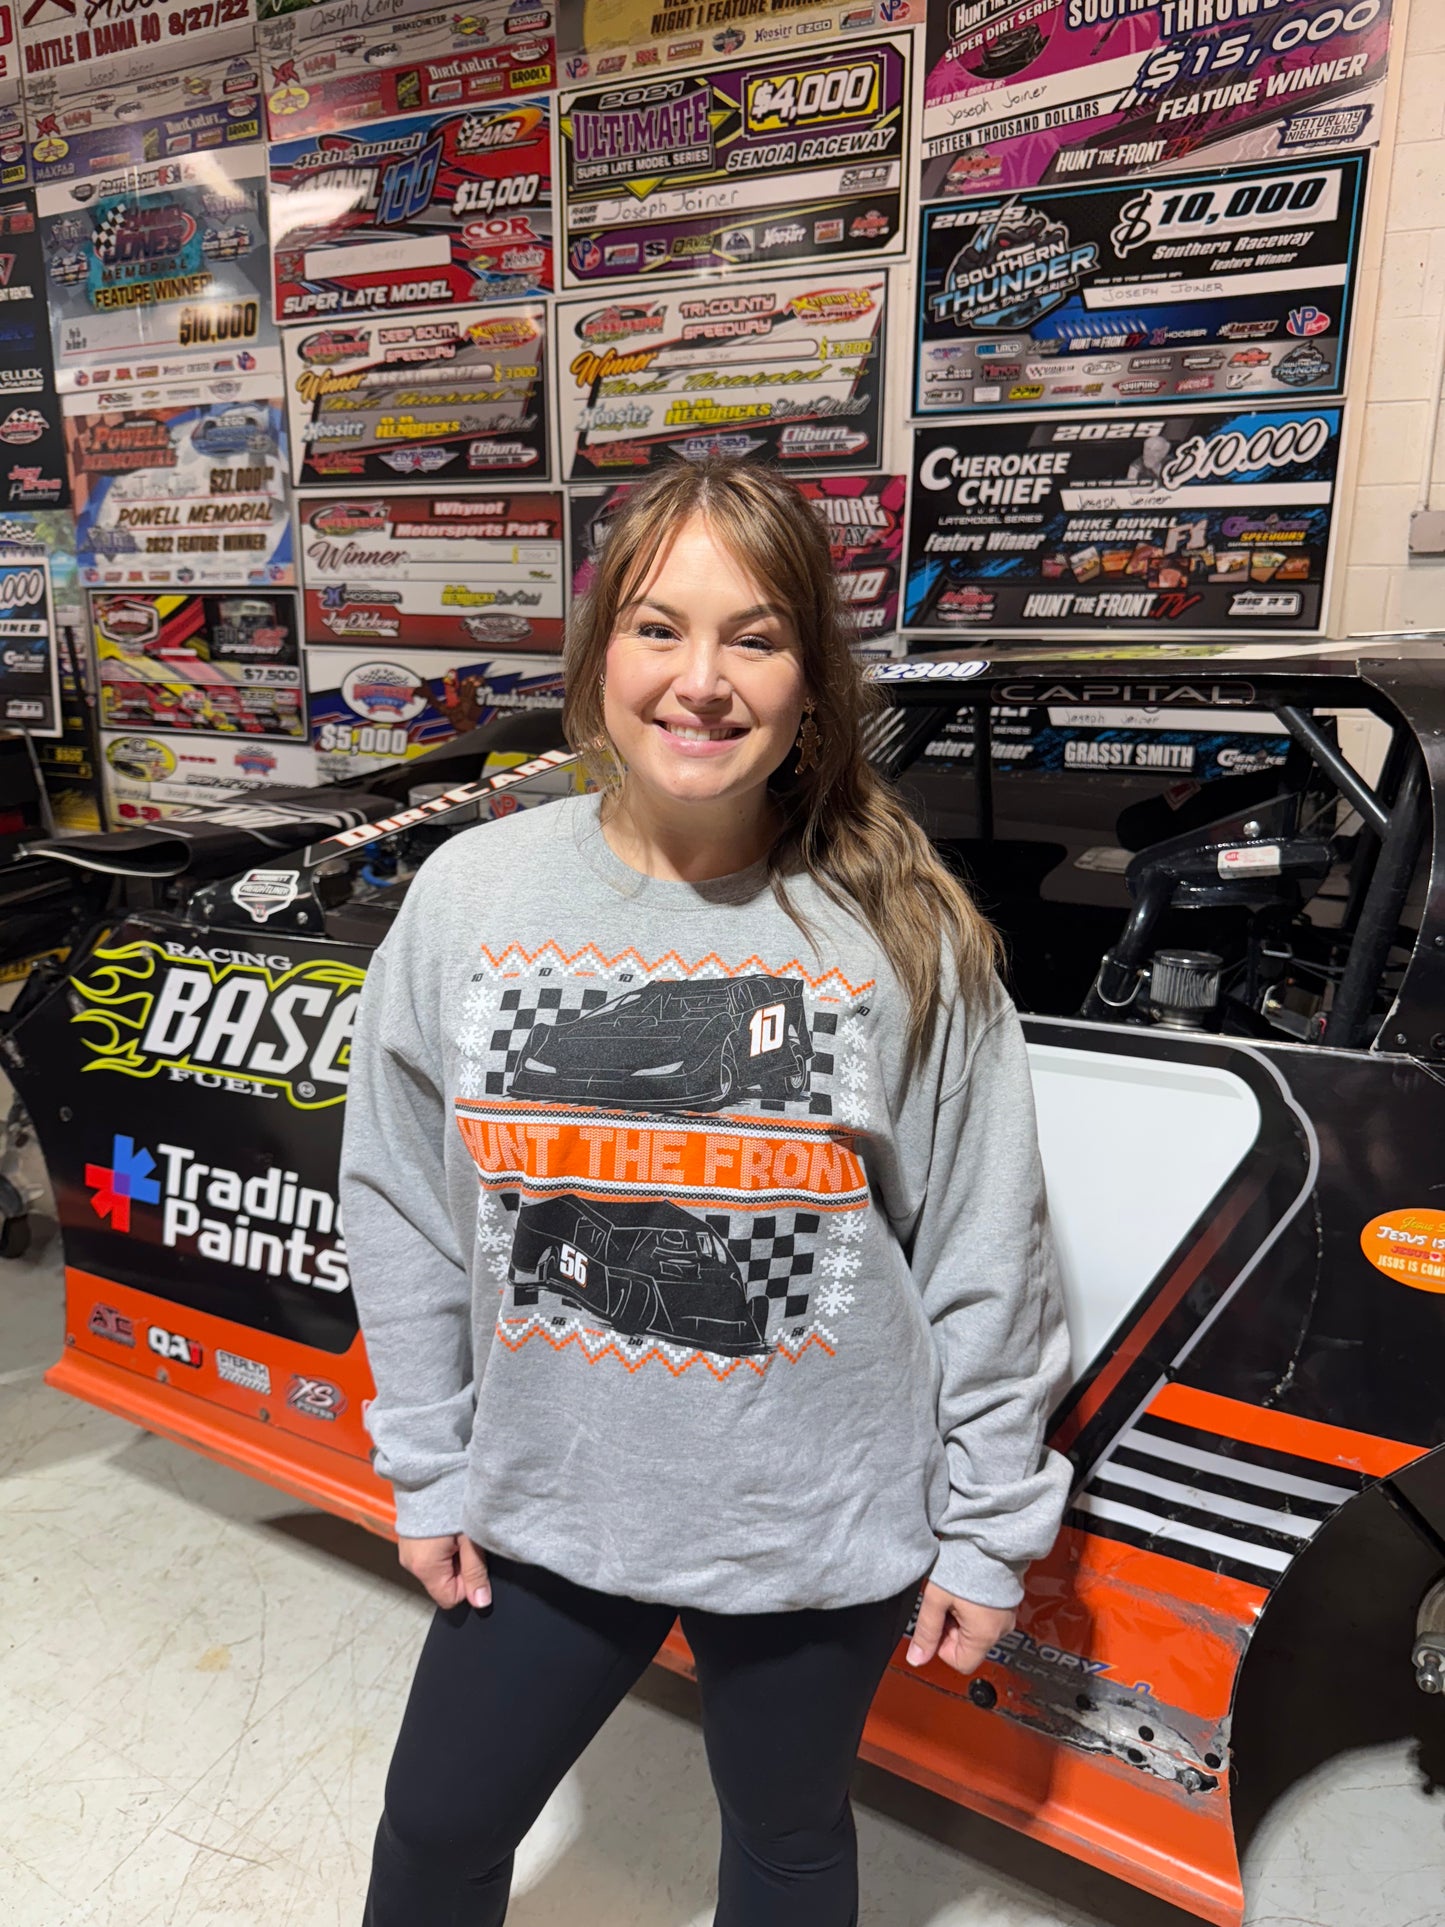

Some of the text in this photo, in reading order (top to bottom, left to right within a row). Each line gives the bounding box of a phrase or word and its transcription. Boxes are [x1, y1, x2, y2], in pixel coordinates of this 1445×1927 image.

[651, 7, 694, 35] NIGHT
[754, 25, 792, 43] Hoosier
[797, 20, 831, 35] EZGO
[945, 0, 1064, 62] SUPER DIRT SERIES
[25, 37, 75, 74] BATTLE
[93, 18, 138, 57] BAMA
[141, 12, 160, 44] 40
[168, 0, 249, 36] 8/27/22
[511, 68, 547, 84] BRODIX
[1155, 53, 1368, 123] FEATURE WINNER
[598, 80, 685, 110] 2021
[750, 65, 875, 121] $4,000
[945, 85, 1047, 127] Joseph Joiner
[572, 86, 712, 163] ULTIMATE
[928, 101, 1100, 158] FIFTEEN THOUSAND DOLLARS
[1286, 123, 1359, 144] NIGHT SIGNS
[1291, 107, 1363, 134] SATURDAY
[292, 133, 422, 176] 46th Annual
[576, 149, 708, 181] SUPER LATE MODEL SERIES
[726, 127, 897, 173] SENOIA RACEWAY
[1056, 148, 1115, 173] HUNT THE
[452, 174, 540, 216] $15,000
[602, 190, 738, 222] Joseph Joiner
[464, 219, 535, 244] COR
[931, 205, 1028, 230] 2025
[1112, 177, 1327, 258] $10,000
[1151, 231, 1314, 261] Southern Raceway
[955, 240, 1066, 289] SOUTHERN
[1209, 252, 1297, 272] Feature Winner
[96, 282, 152, 309] FEATURE
[932, 246, 1095, 317] THUNDER
[1100, 287, 1159, 304] JOSEPH
[283, 292, 338, 314] SUPER
[341, 288, 388, 307] LATE
[390, 281, 453, 303] MODEL
[679, 294, 776, 319] TRI-COUNTY
[378, 321, 459, 344] DEEP SOUTH
[682, 319, 772, 341] SPEEDWAY
[570, 347, 659, 389] Winner
[575, 402, 654, 432] Hoosier
[664, 404, 772, 426] HENDRICKS
[781, 426, 850, 445] Cliburn
[1051, 421, 1166, 441] 2025
[469, 440, 523, 459] Cliburn
[919, 446, 1072, 491] CHEROKEE
[957, 477, 1054, 507] CHIEF
[117, 502, 273, 531] POWELL MEMORIAL
[433, 500, 509, 518] Whynot
[393, 520, 503, 540] Motorsports
[505, 520, 552, 539] Park
[1062, 529, 1154, 543] MEMORIAL
[1066, 517, 1179, 532] MIKE DUVALL
[306, 540, 407, 570] Winner
[923, 531, 1047, 552] Feature Winner
[1023, 593, 1098, 618] HUNT THE
[998, 683, 1250, 707] CAPITAL
[317, 721, 411, 758] $5,000
[1064, 741, 1194, 768] GRASSY SMITH
[165, 940, 293, 977] RACING
[749, 1003, 786, 1058] 10
[166, 1067, 279, 1100] FUEL
[578, 1126, 687, 1183] THE
[156, 1142, 345, 1238] Tradin
[161, 1196, 350, 1294] Paints
[1376, 1225, 1428, 1246] JESUS
[559, 1242, 590, 1290] 56
[1378, 1254, 1445, 1278] JESUS IS COMI
[148, 1326, 203, 1367] QA1
